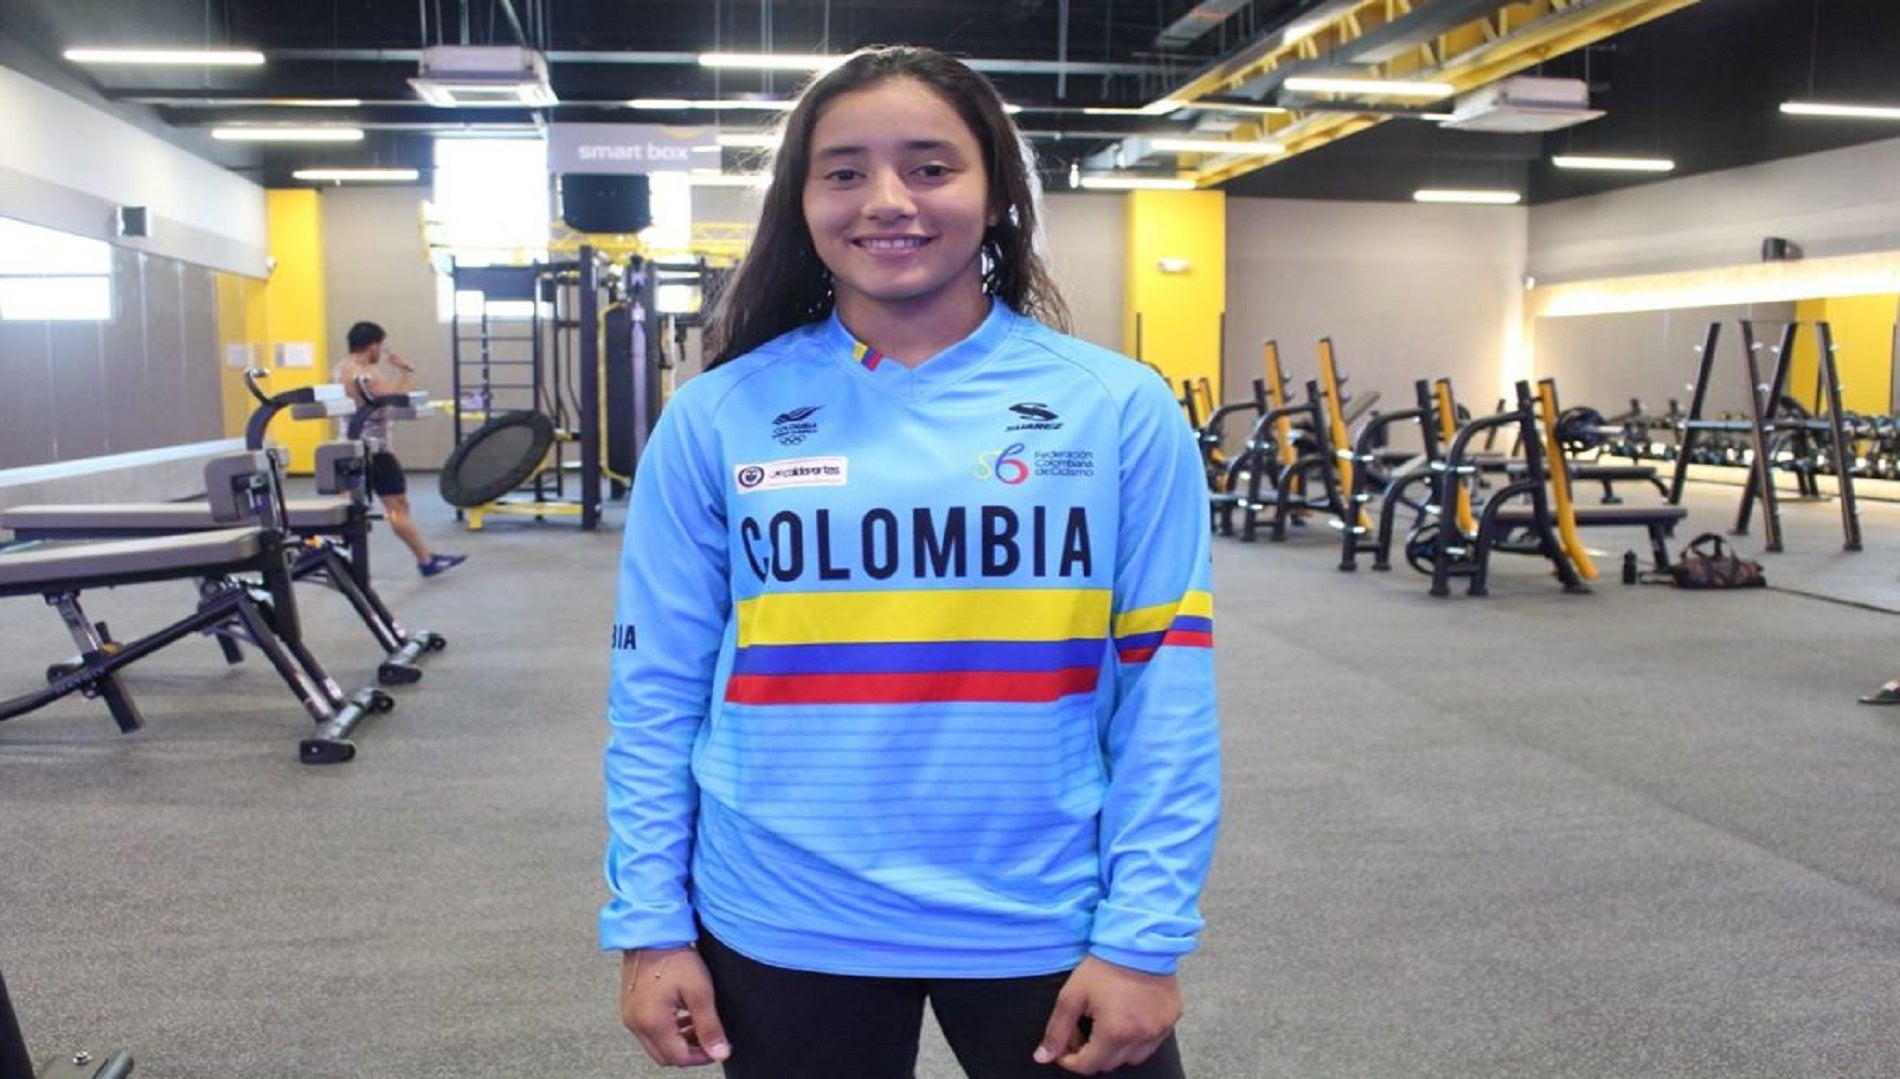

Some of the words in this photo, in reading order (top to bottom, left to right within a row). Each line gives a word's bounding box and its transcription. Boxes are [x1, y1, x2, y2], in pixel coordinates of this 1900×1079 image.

[578, 144, 642, 160] smart
[648, 143, 688, 160] box
[741, 505, 1093, 583] COLOMBIA
